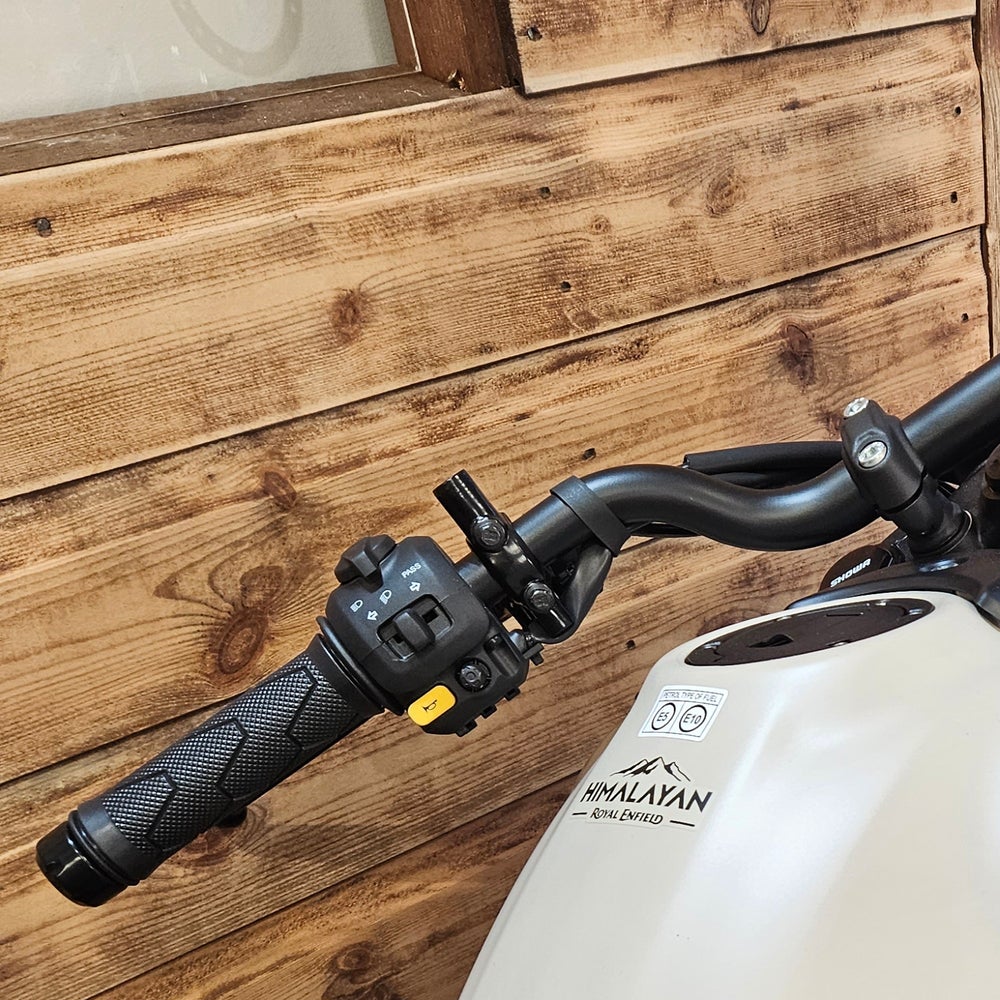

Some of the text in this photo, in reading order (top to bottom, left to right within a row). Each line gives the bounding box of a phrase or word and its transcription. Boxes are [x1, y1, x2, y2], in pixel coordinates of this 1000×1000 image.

[401, 562, 422, 579] PASS
[830, 558, 871, 588] SHOWA
[681, 692, 694, 700] TYPE
[694, 693, 704, 701] OF
[703, 695, 718, 703] FUEL
[656, 712, 702, 725] E5 E10
[580, 781, 713, 813] HIMALAYAN
[590, 807, 664, 825] ROYAL ENFIELD
